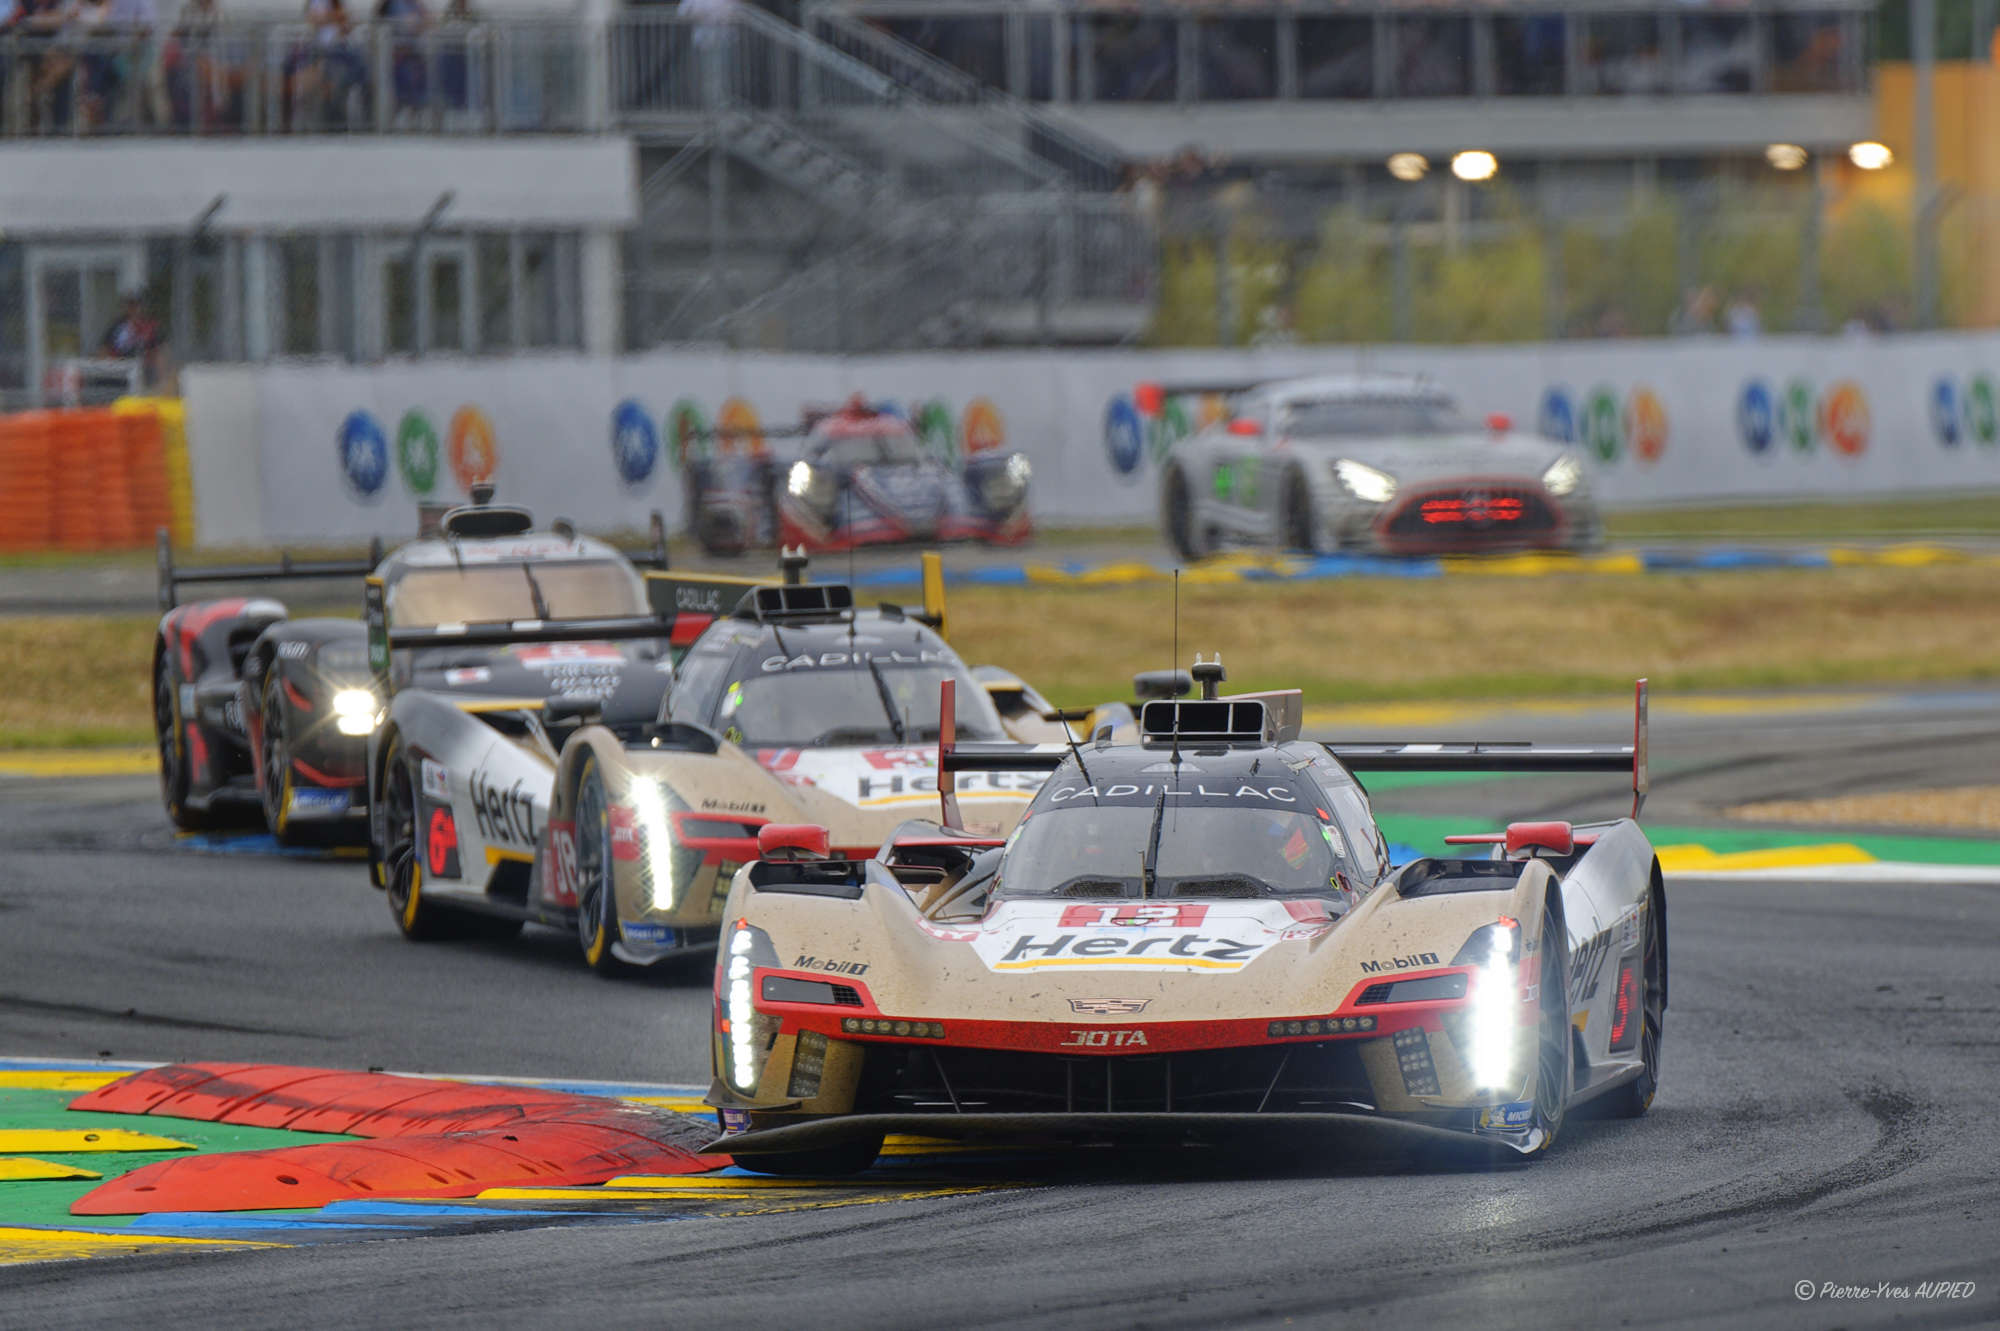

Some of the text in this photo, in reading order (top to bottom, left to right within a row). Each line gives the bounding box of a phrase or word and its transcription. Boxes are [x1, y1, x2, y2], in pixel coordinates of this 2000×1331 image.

[1050, 783, 1297, 803] CADILLAC
[469, 767, 538, 847] Hertz
[1000, 934, 1264, 961] Hertz
[793, 955, 852, 973] Mobil
[1360, 955, 1421, 973] Mobil
[1060, 1029, 1149, 1046] JOTA
